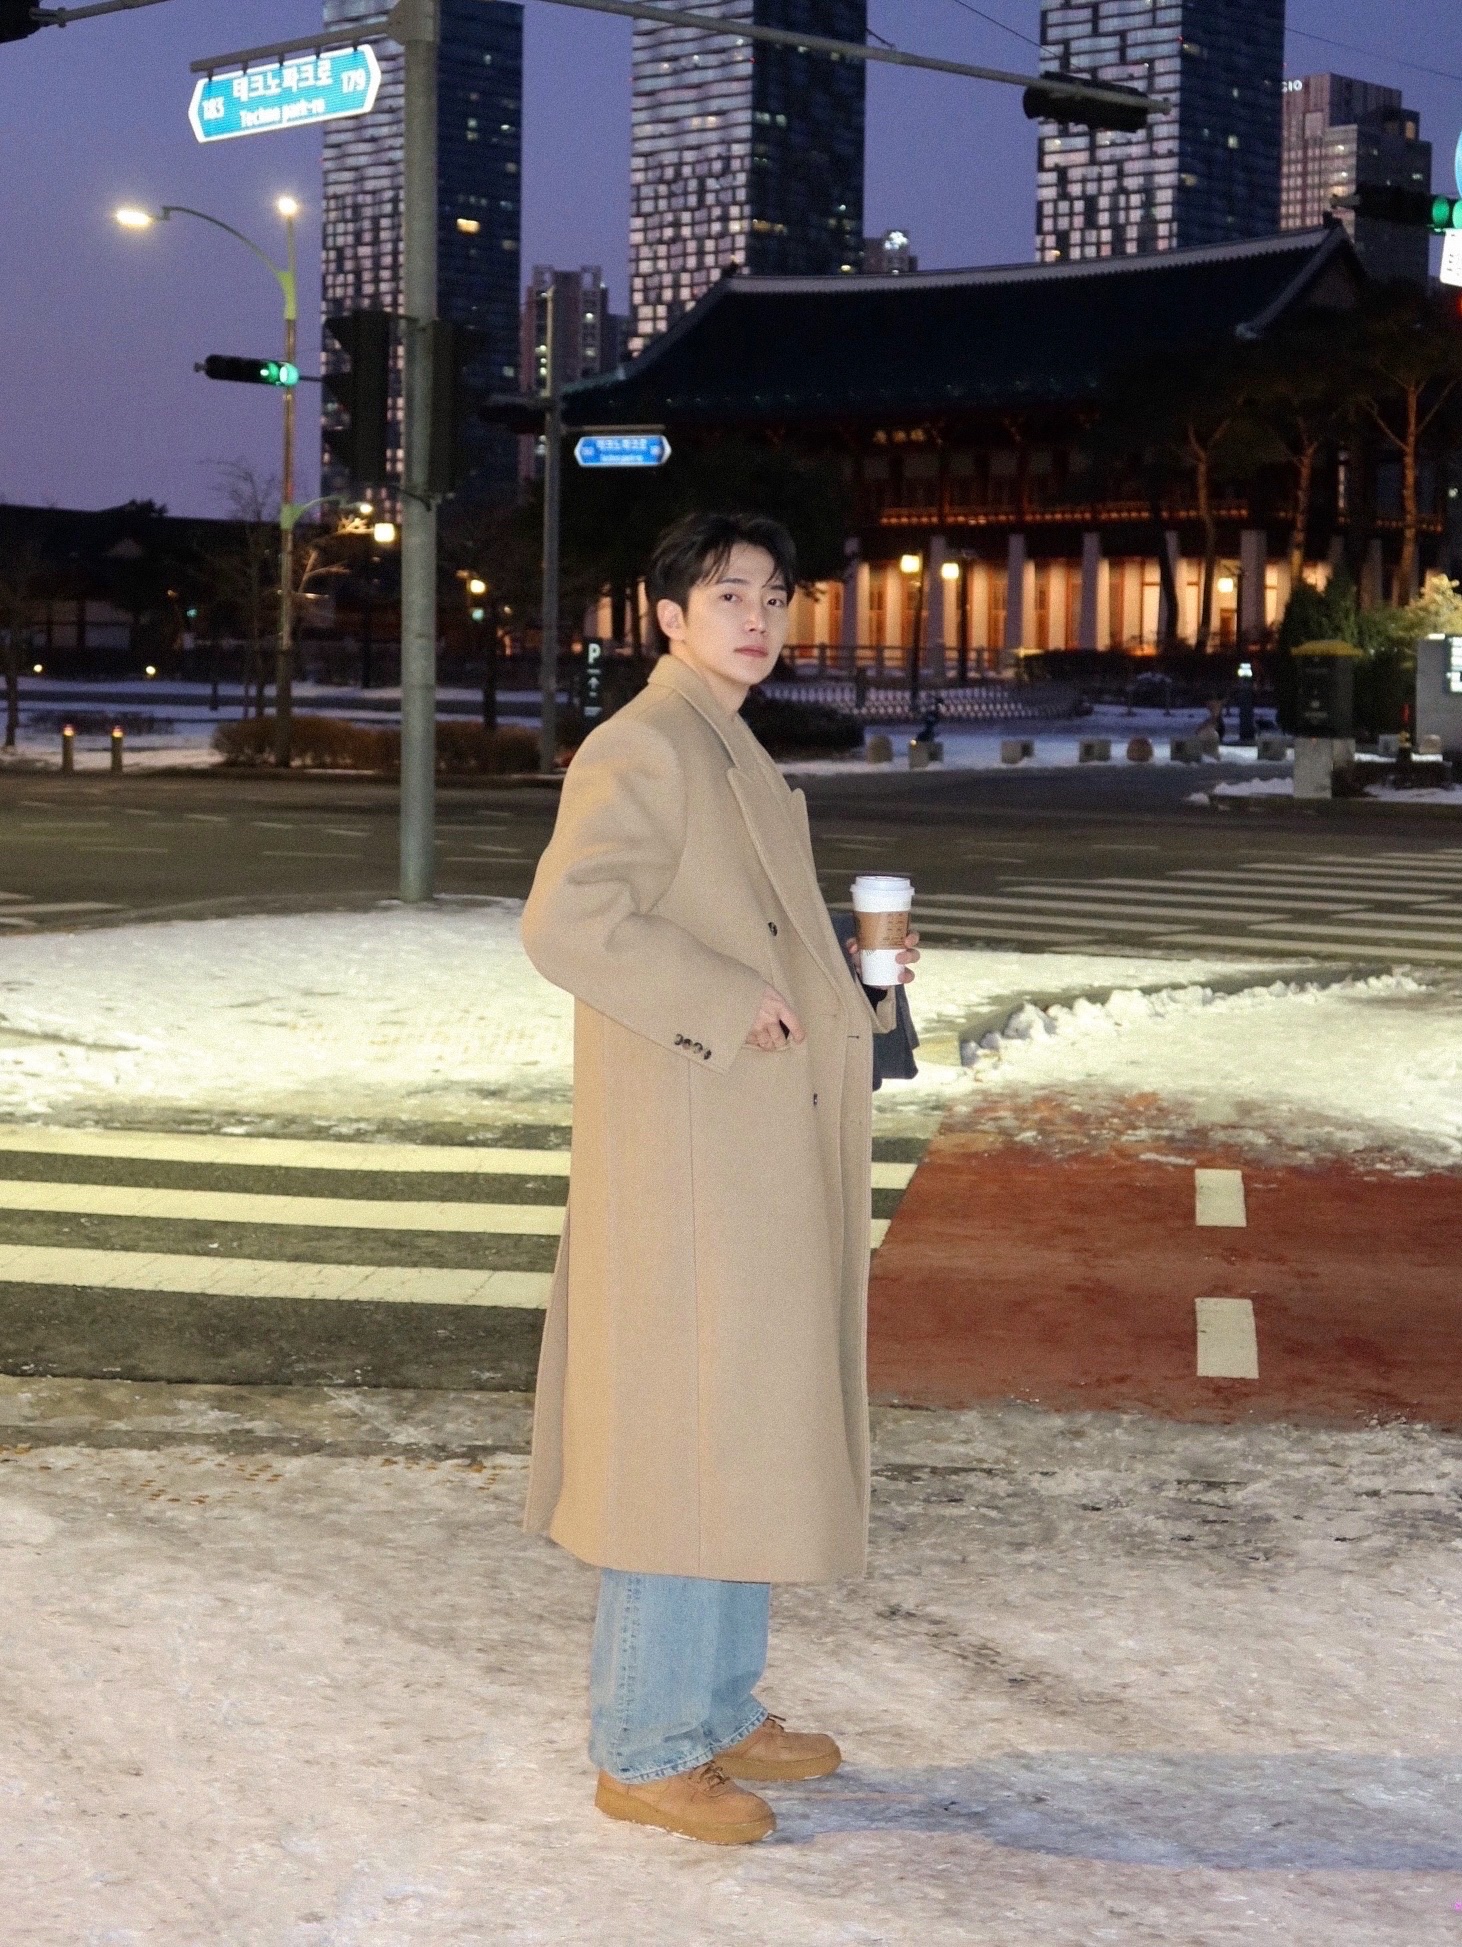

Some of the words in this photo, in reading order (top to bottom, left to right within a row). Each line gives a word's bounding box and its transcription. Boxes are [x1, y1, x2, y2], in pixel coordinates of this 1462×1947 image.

[233, 59, 332, 102] 테크노파크로
[340, 68, 366, 93] 179
[588, 643, 601, 664] P
